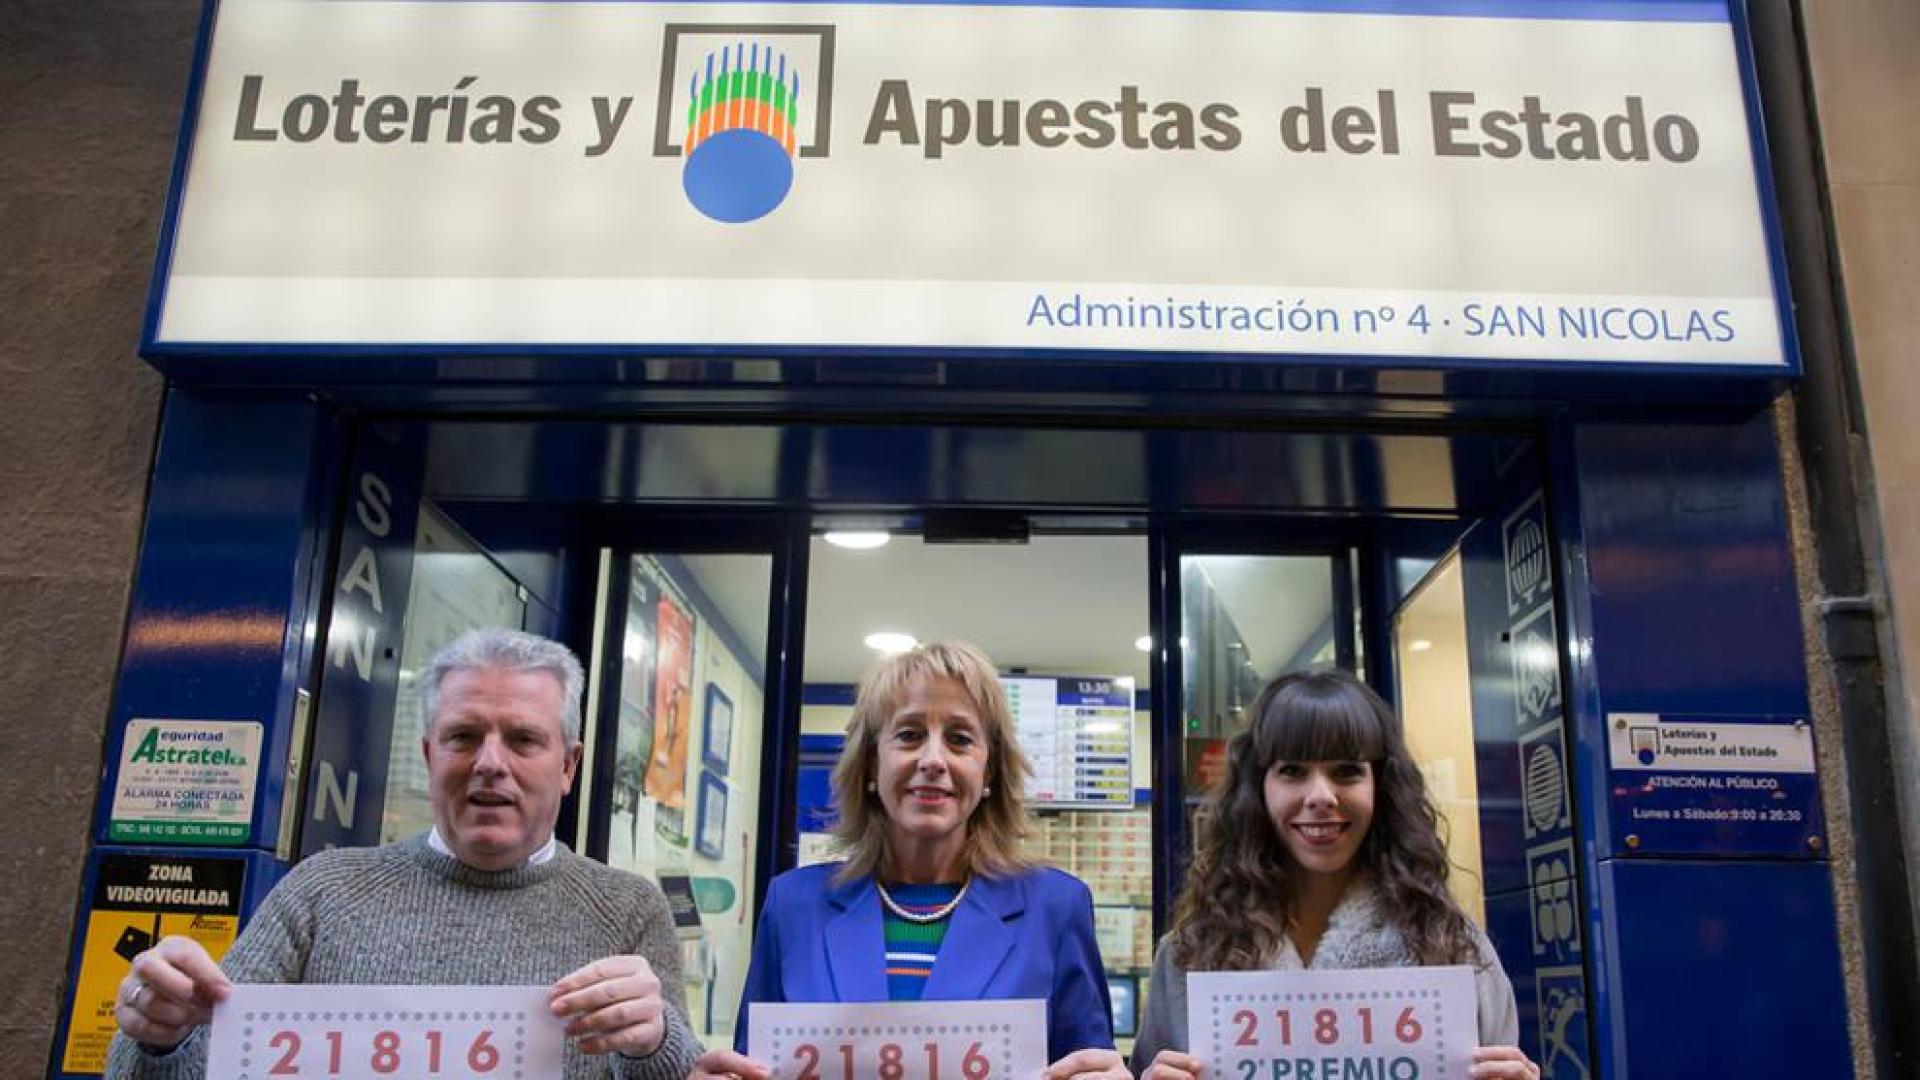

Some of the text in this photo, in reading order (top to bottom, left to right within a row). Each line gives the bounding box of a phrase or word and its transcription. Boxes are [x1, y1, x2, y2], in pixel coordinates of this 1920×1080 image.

[233, 74, 1700, 164] Loterías y Apuestas del Estado
[1025, 293, 1340, 335] Administración
[1406, 303, 1432, 336] 4
[1462, 304, 1546, 338] SAN
[1557, 306, 1735, 343] NICOLAS
[130, 726, 232, 765] Astratel
[1664, 744, 1778, 758] Apuestas del Estado
[124, 788, 245, 802] ALARMA CONECTADA
[1648, 775, 1778, 790] ATENCIÓN AL PÚBLICO
[1632, 807, 1671, 820] Lunes
[149, 864, 193, 882] ZONA
[106, 886, 230, 907] VIDEOVIGILADA
[1231, 1005, 1424, 1046] 21816
[267, 1029, 501, 1075] 21816
[793, 1040, 990, 1080] 21816
[1271, 1055, 1420, 1080] PREMIO
